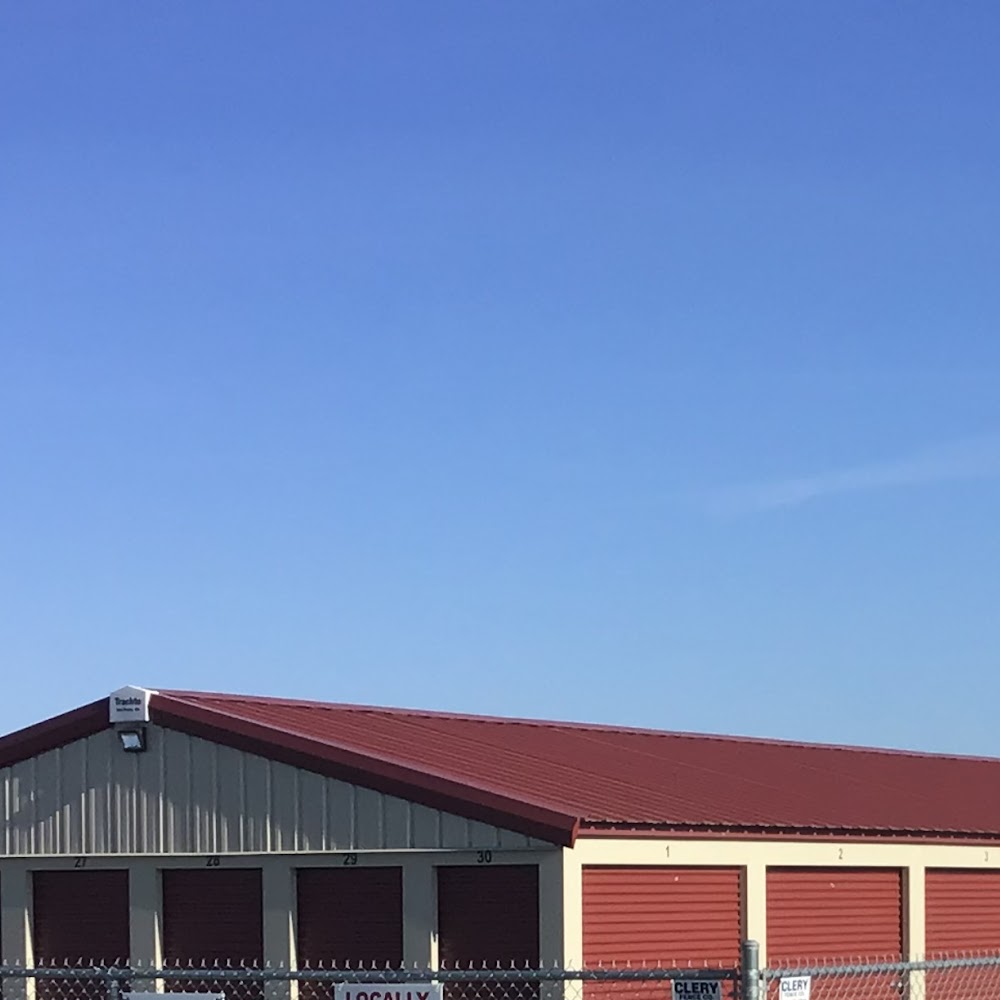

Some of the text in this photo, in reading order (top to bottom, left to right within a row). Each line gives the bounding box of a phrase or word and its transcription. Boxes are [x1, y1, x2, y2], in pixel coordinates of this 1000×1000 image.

[477, 850, 492, 863] 30
[665, 845, 670, 858] 1
[838, 848, 844, 860] 2
[74, 857, 87, 868] 27
[206, 856, 221, 867] 28
[343, 853, 358, 865] 29
[674, 982, 718, 994] CLERY
[781, 980, 808, 992] CLERY
